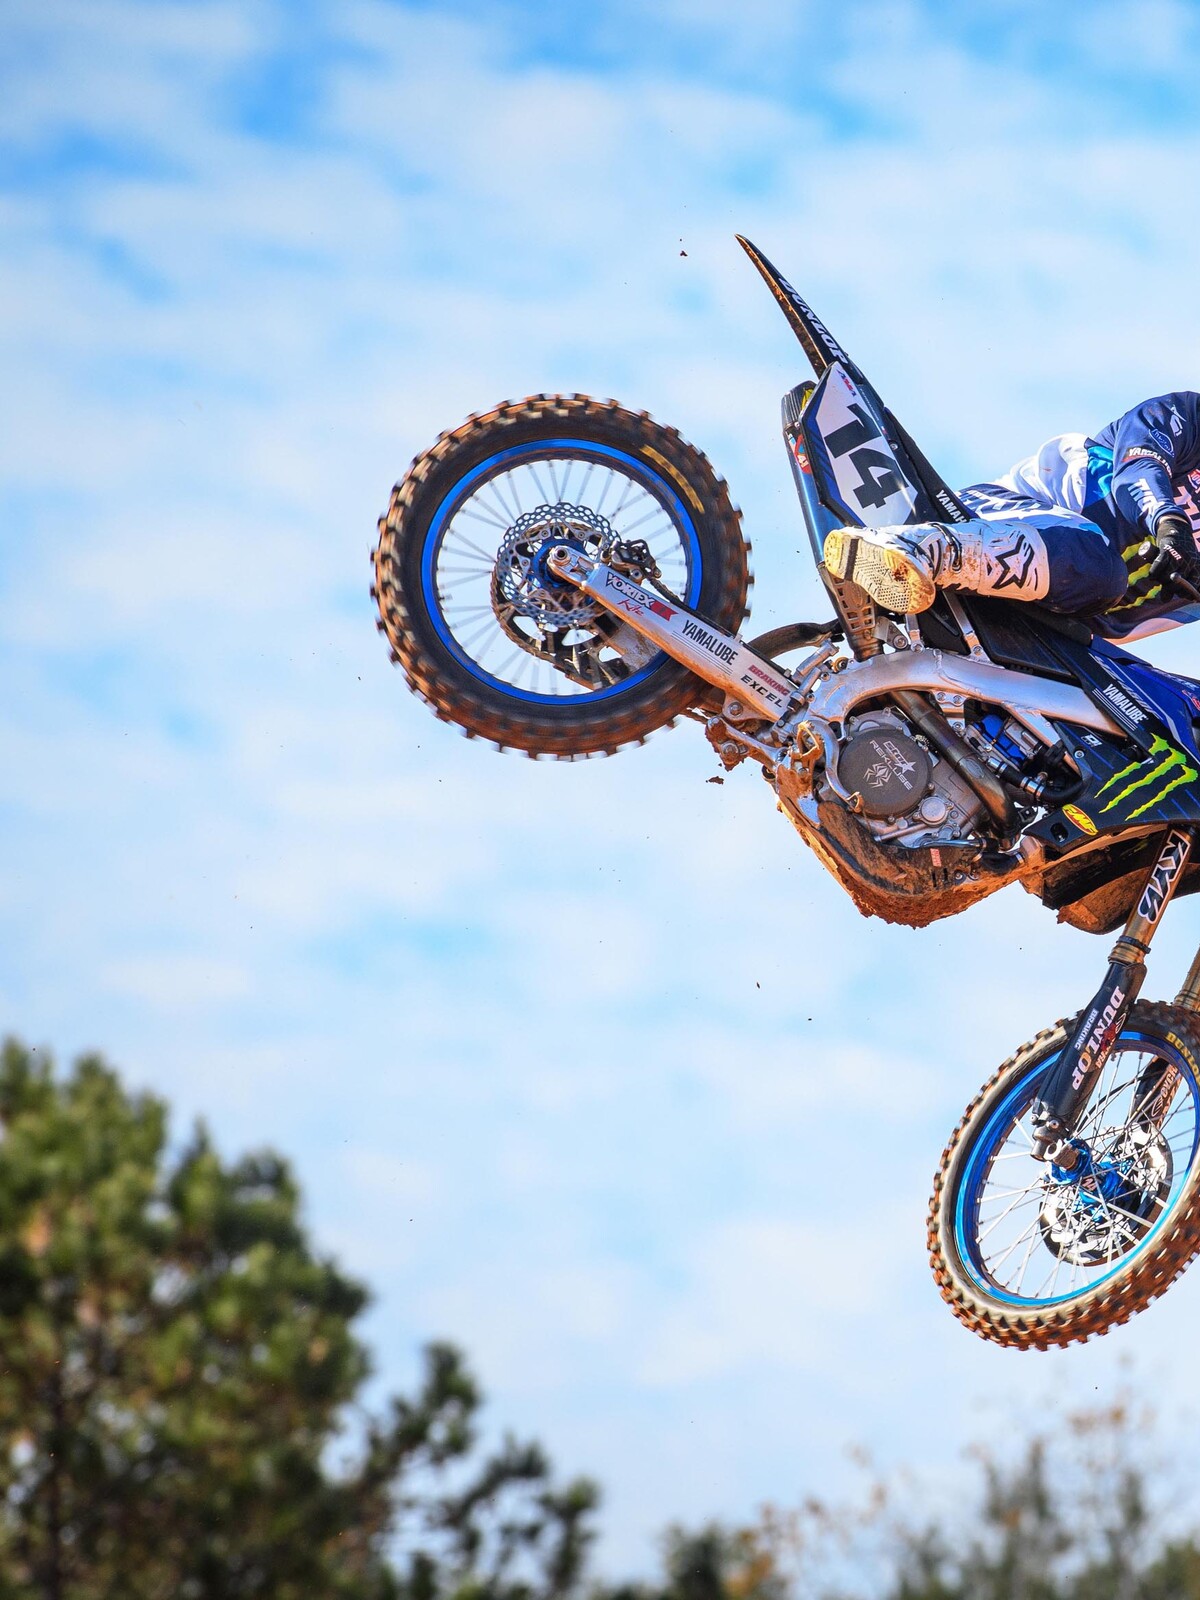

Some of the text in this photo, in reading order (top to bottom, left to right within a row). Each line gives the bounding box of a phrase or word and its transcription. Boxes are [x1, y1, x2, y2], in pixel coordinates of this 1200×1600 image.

[779, 278, 848, 365] DUNLOP
[824, 402, 909, 509] 14
[935, 489, 968, 523] YAMAH
[605, 572, 656, 609] VORTEX
[682, 620, 738, 665] YAMALUBE
[741, 674, 784, 708] EXCEL
[748, 665, 790, 696] BRAKING
[1102, 683, 1147, 724] YAMALUBE
[869, 740, 913, 790] REKLUSE
[1137, 829, 1191, 924] KYB
[1072, 986, 1125, 1090] DUNLOP
[1073, 1008, 1099, 1050] BRAKING
[1162, 1064, 1179, 1098] CYCR
